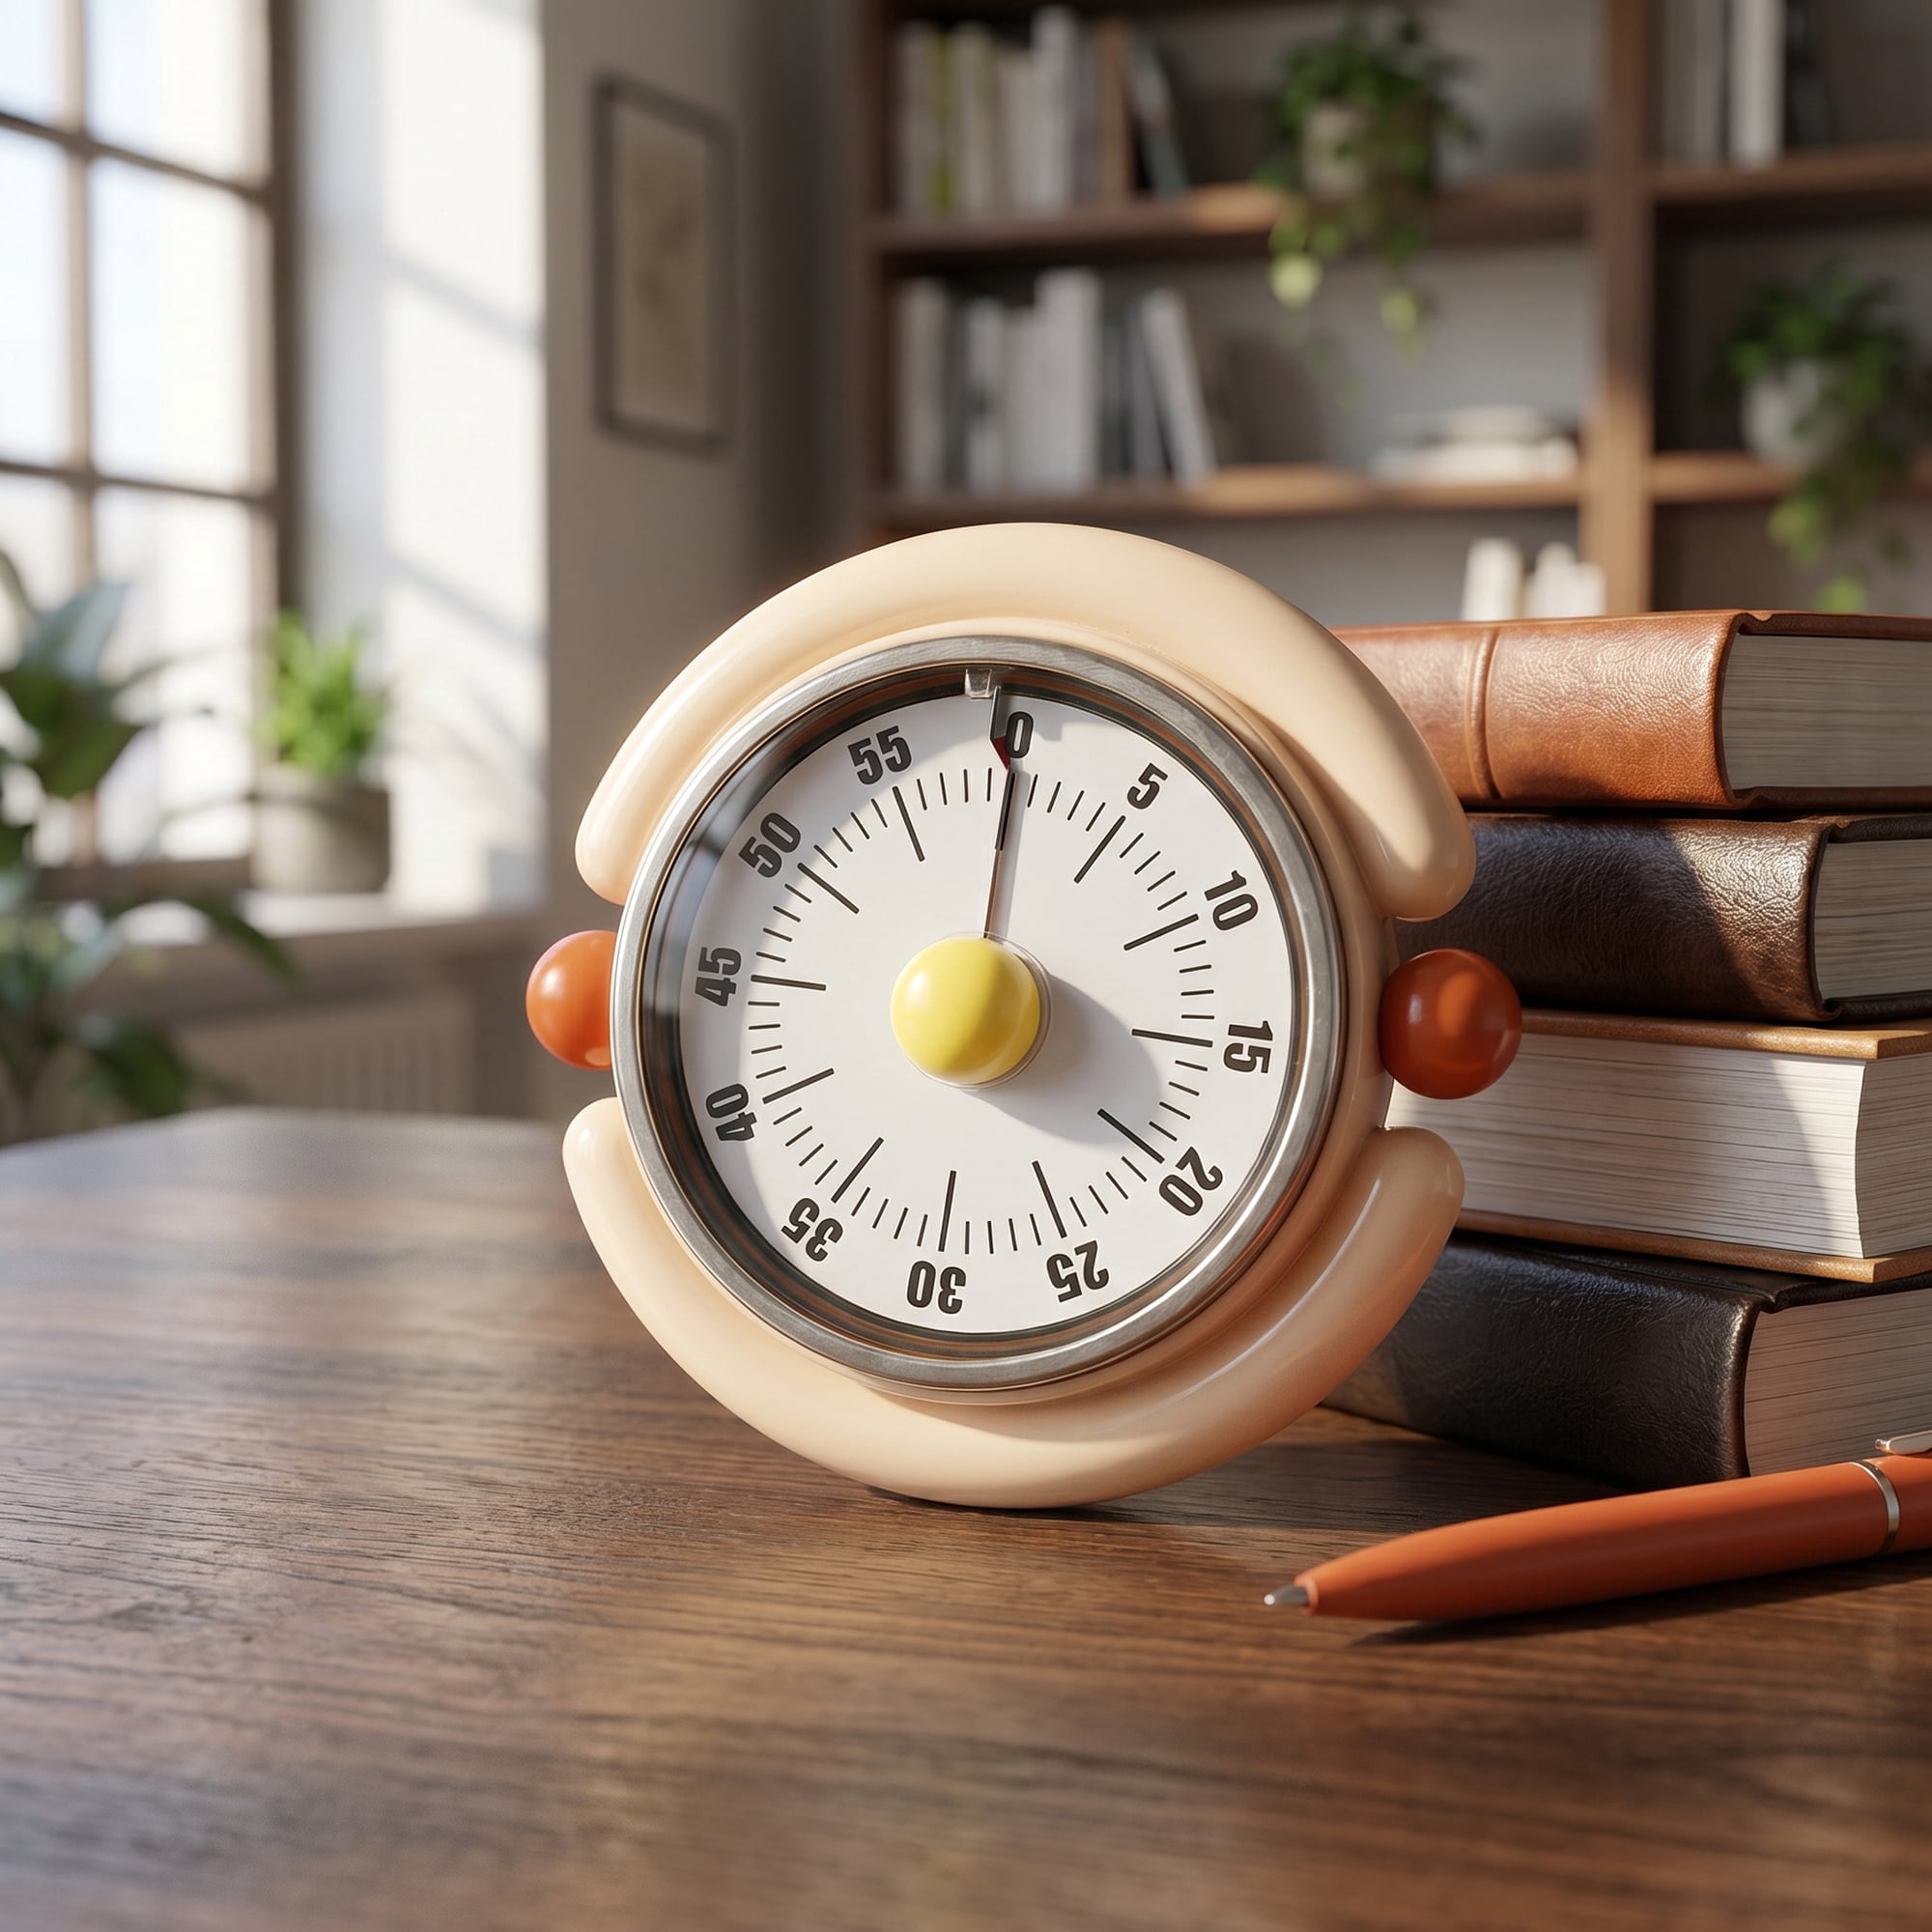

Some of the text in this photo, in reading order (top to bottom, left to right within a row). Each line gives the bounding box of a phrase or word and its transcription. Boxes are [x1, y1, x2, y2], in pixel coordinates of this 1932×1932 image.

[846, 724, 912, 785] 55
[1005, 711, 1034, 758] 0
[1126, 762, 1169, 810] 5
[737, 811, 802, 878] 50
[1204, 869, 1259, 931] 10
[694, 946, 742, 1008] 45
[1223, 1020, 1273, 1074] 15
[704, 1083, 757, 1142] 40
[1158, 1146, 1223, 1216] 20
[781, 1197, 843, 1263] 35
[906, 1261, 967, 1315] 30
[1046, 1239, 1110, 1303] 25
